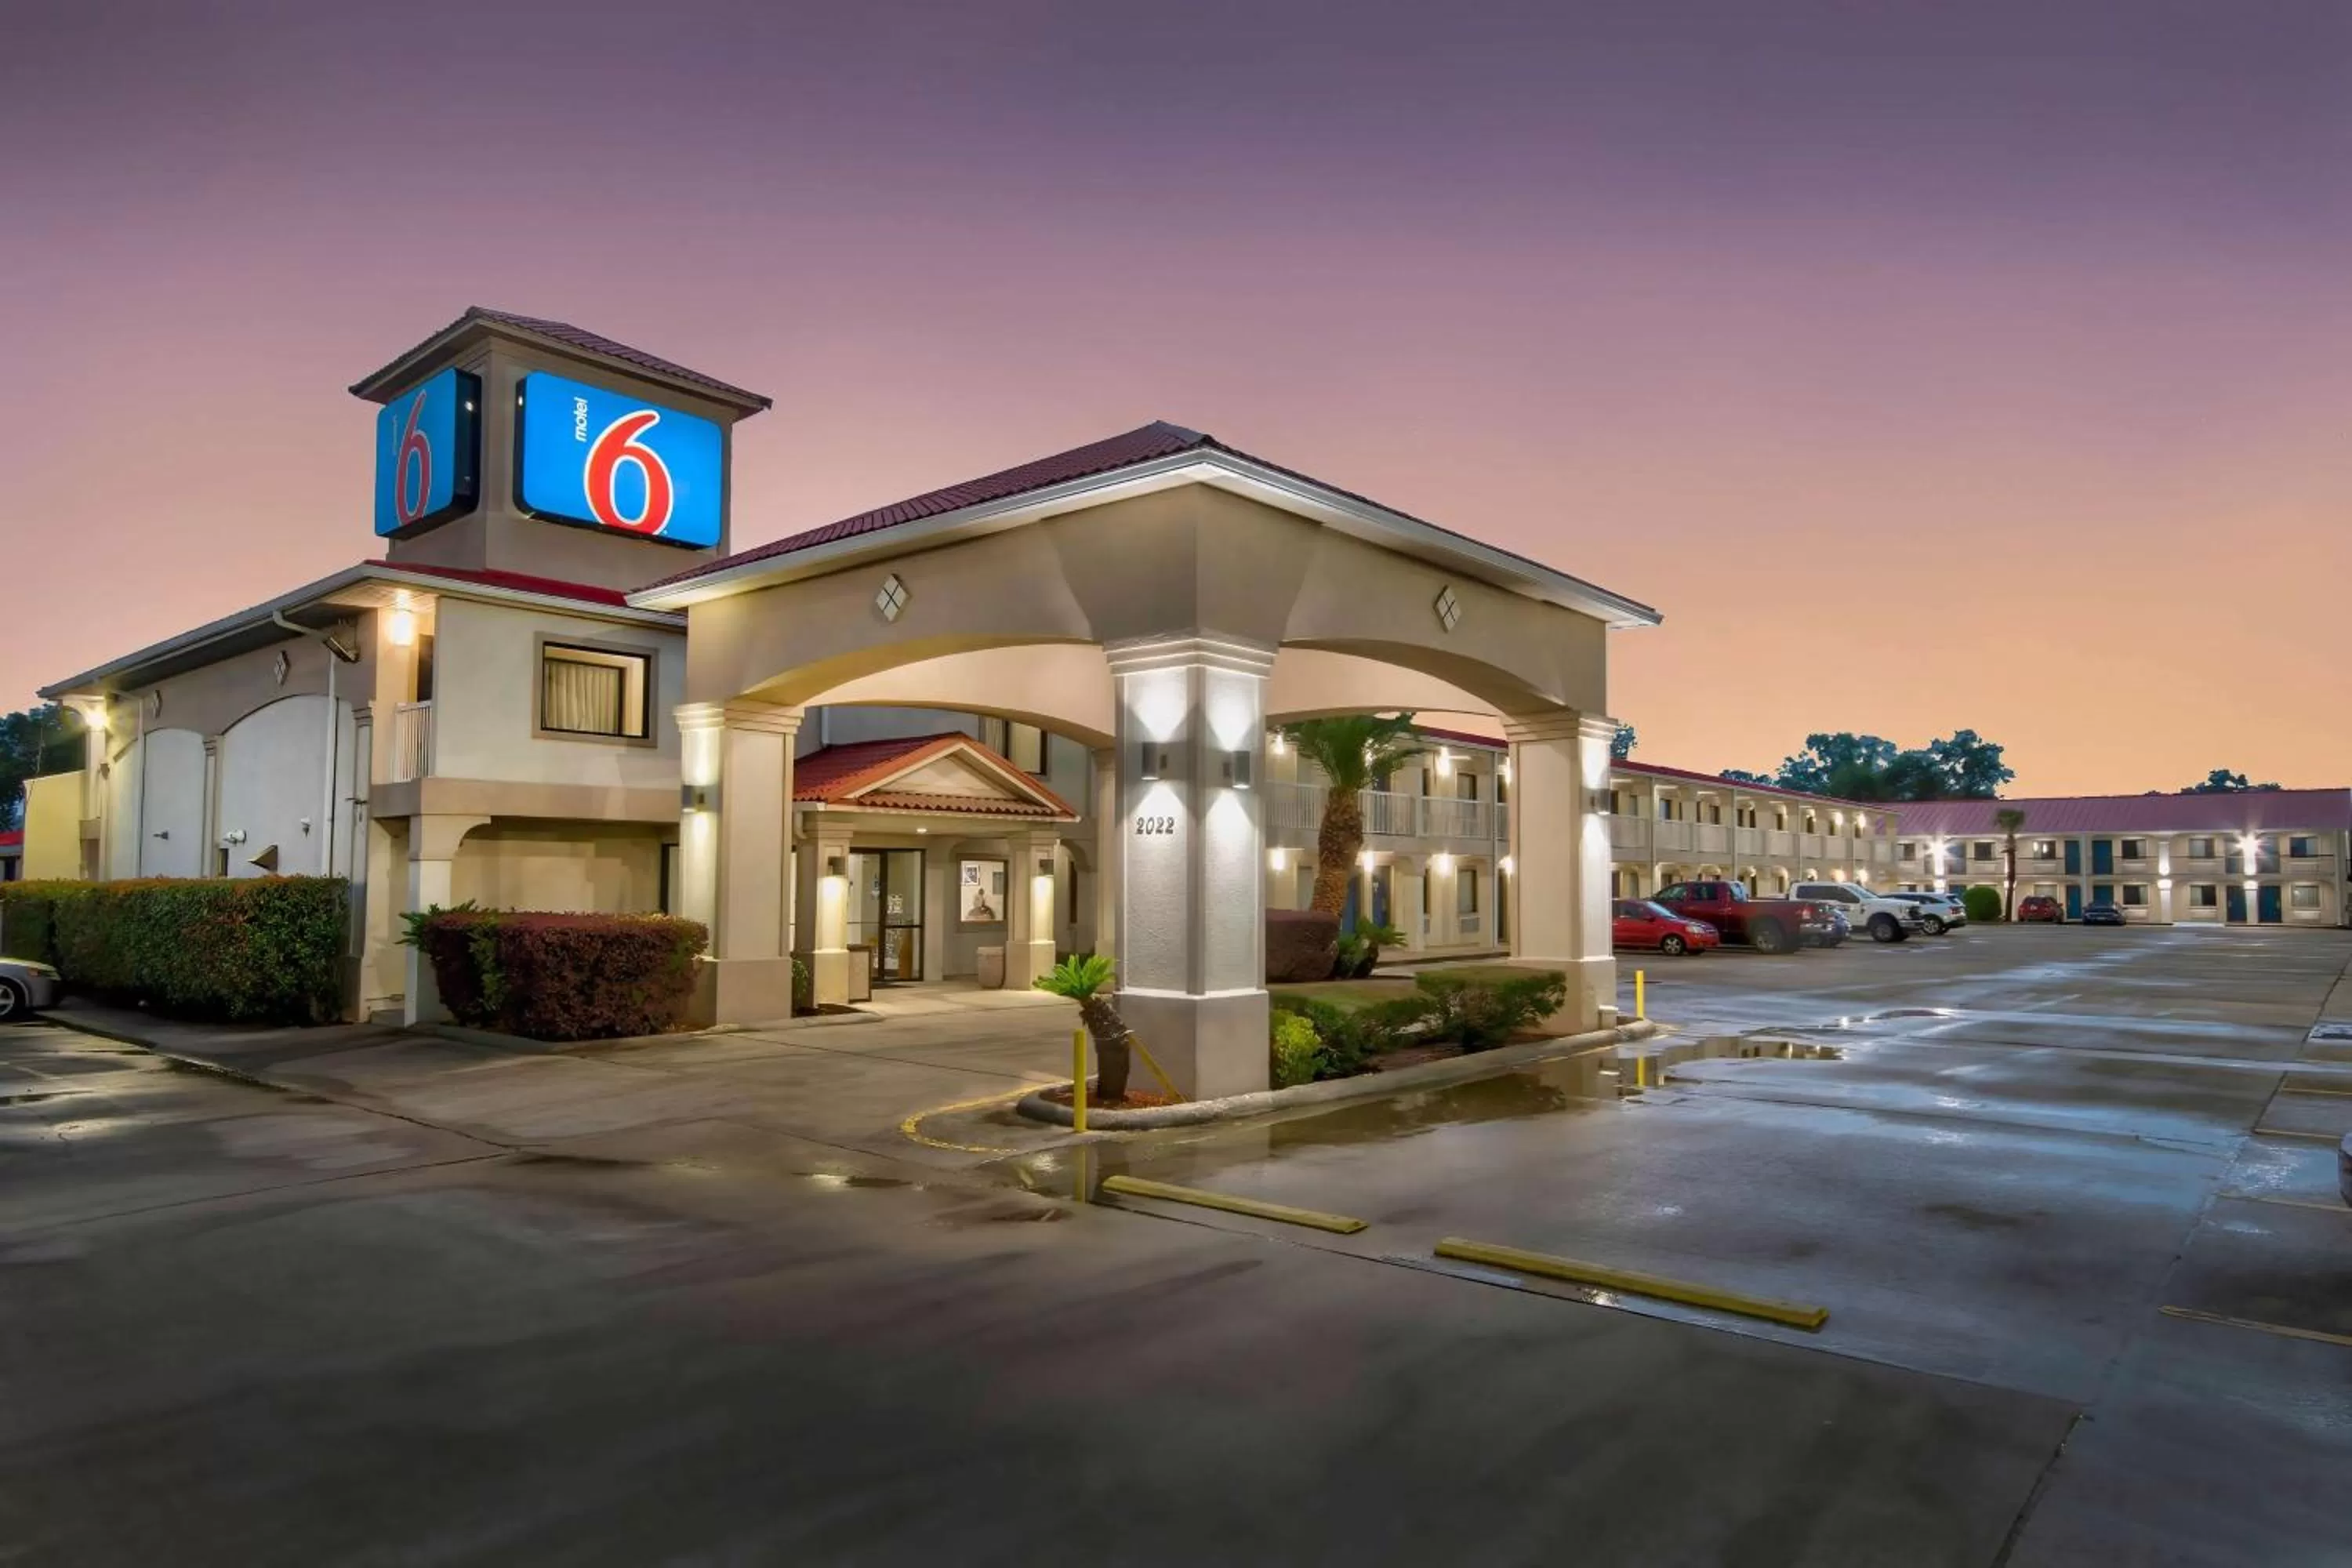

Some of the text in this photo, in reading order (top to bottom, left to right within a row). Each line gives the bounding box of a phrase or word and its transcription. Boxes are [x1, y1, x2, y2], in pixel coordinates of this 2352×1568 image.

[396, 390, 430, 526] 6
[574, 397, 674, 535] motel 6
[1136, 816, 1174, 835] 2022
